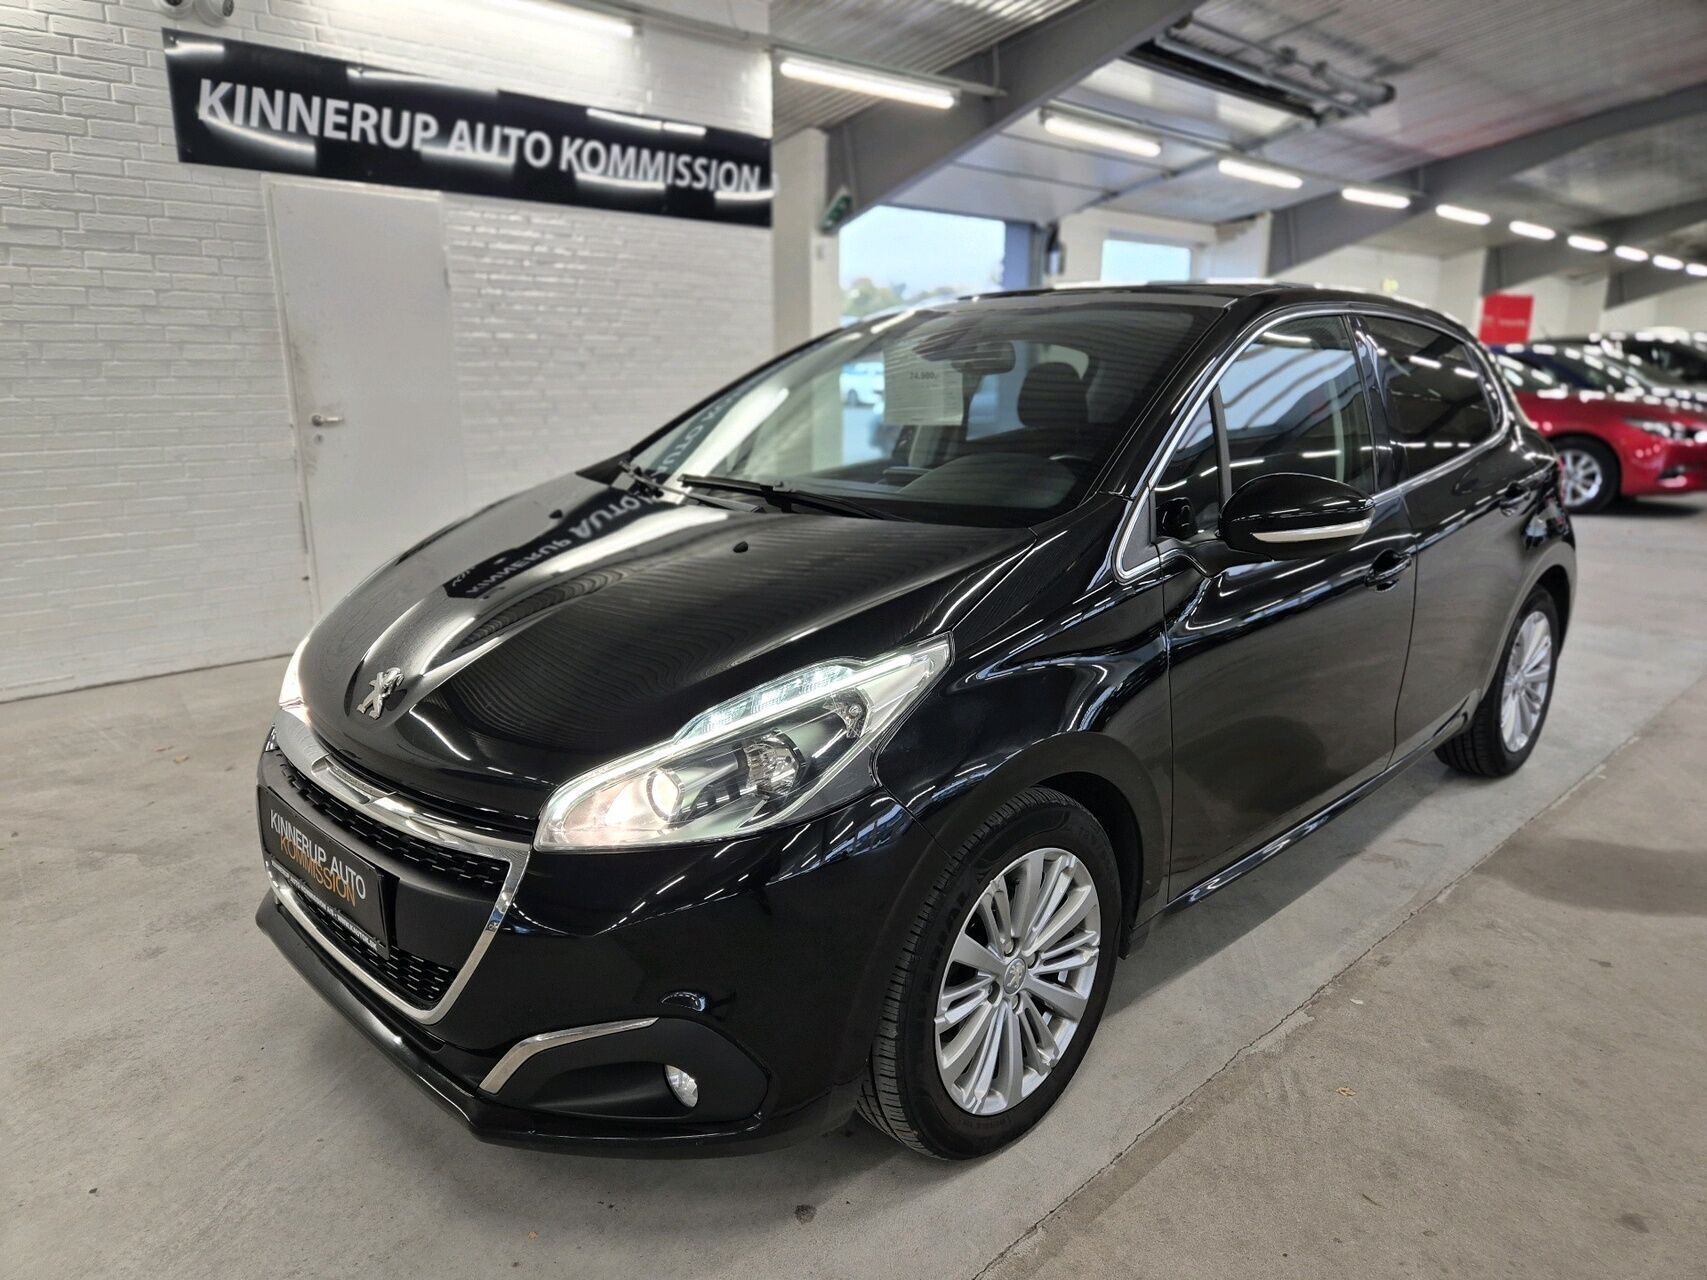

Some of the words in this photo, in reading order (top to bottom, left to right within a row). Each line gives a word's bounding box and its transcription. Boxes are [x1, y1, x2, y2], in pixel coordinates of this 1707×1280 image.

[199, 78, 439, 151] KINNERUP
[446, 120, 553, 168] AUTO
[559, 135, 762, 193] KOMMISSION
[270, 809, 327, 865] KINNERUP
[329, 855, 366, 900] AUTO
[280, 833, 356, 907] KOMMISSION
